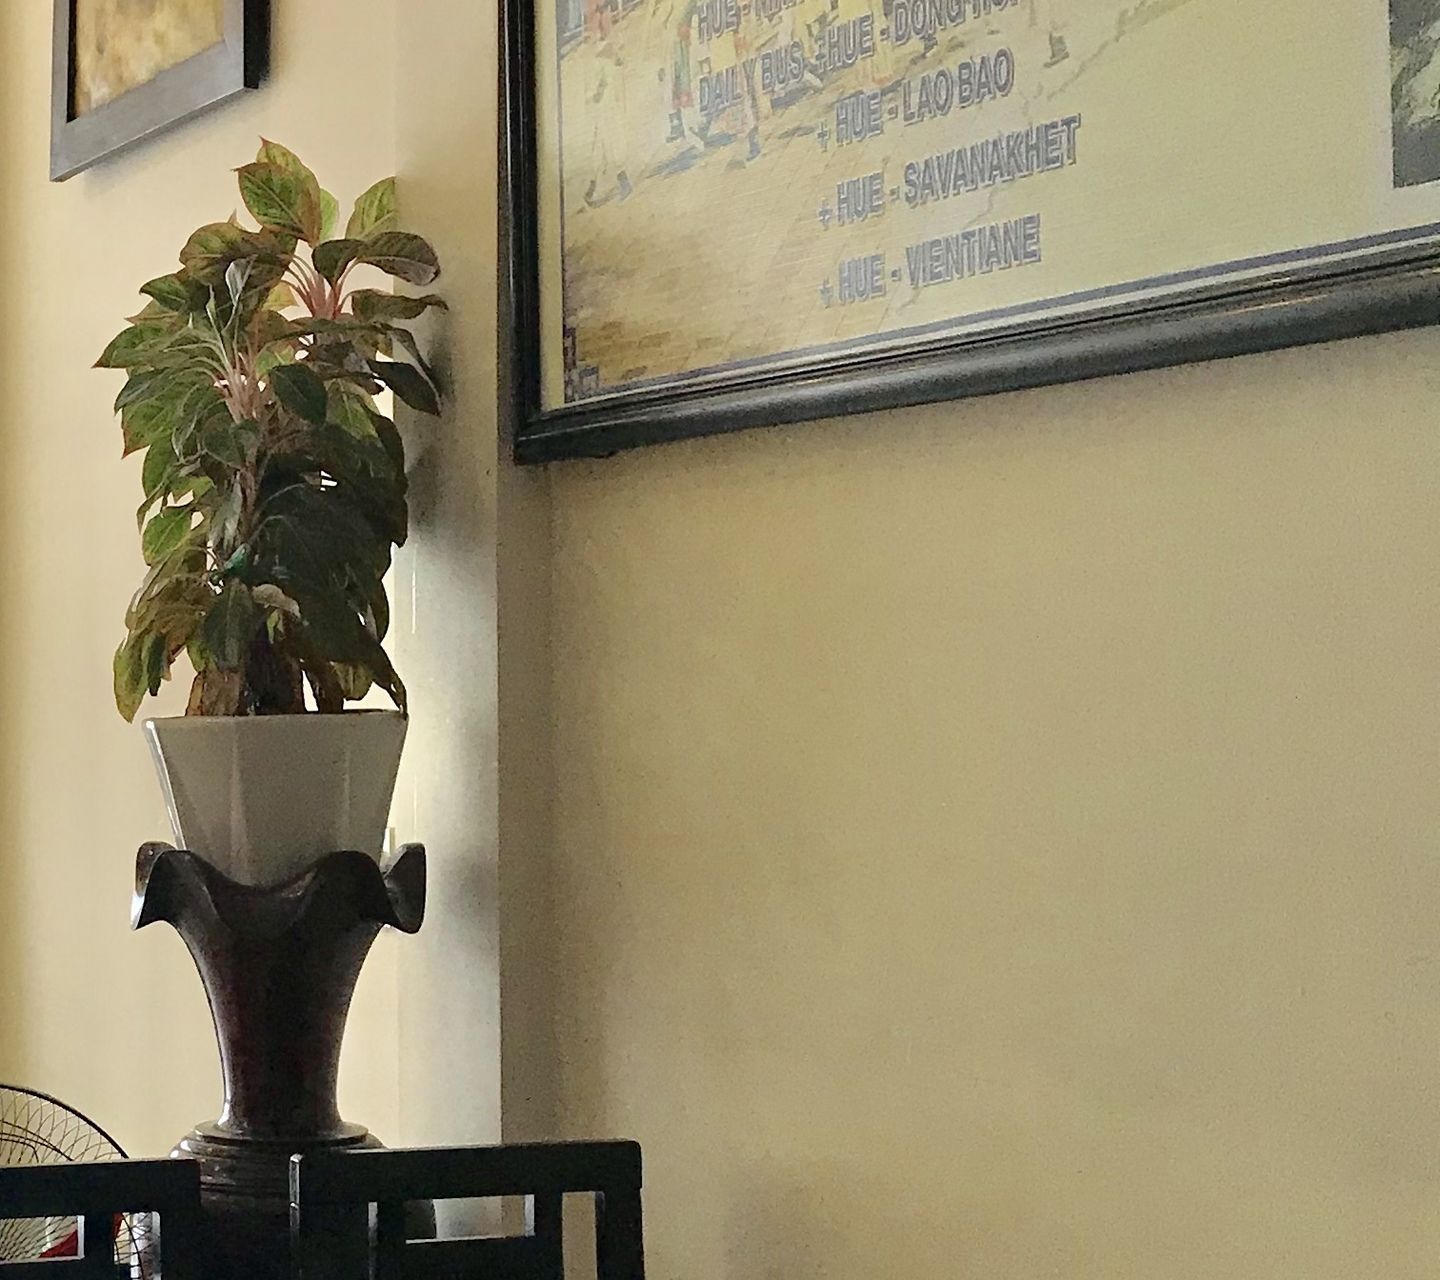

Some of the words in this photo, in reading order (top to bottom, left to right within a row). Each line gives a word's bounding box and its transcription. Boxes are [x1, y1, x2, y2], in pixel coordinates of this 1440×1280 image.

[699, 57, 758, 115] DAILY
[761, 40, 805, 93] BUS
[836, 90, 884, 147] HUE
[903, 70, 955, 127] LAO
[958, 46, 1016, 109] BAO
[836, 171, 885, 226] HUE
[904, 113, 1081, 208] SAVANAKHET
[838, 253, 887, 305] HUE
[906, 213, 1042, 289] VIENTIANE
